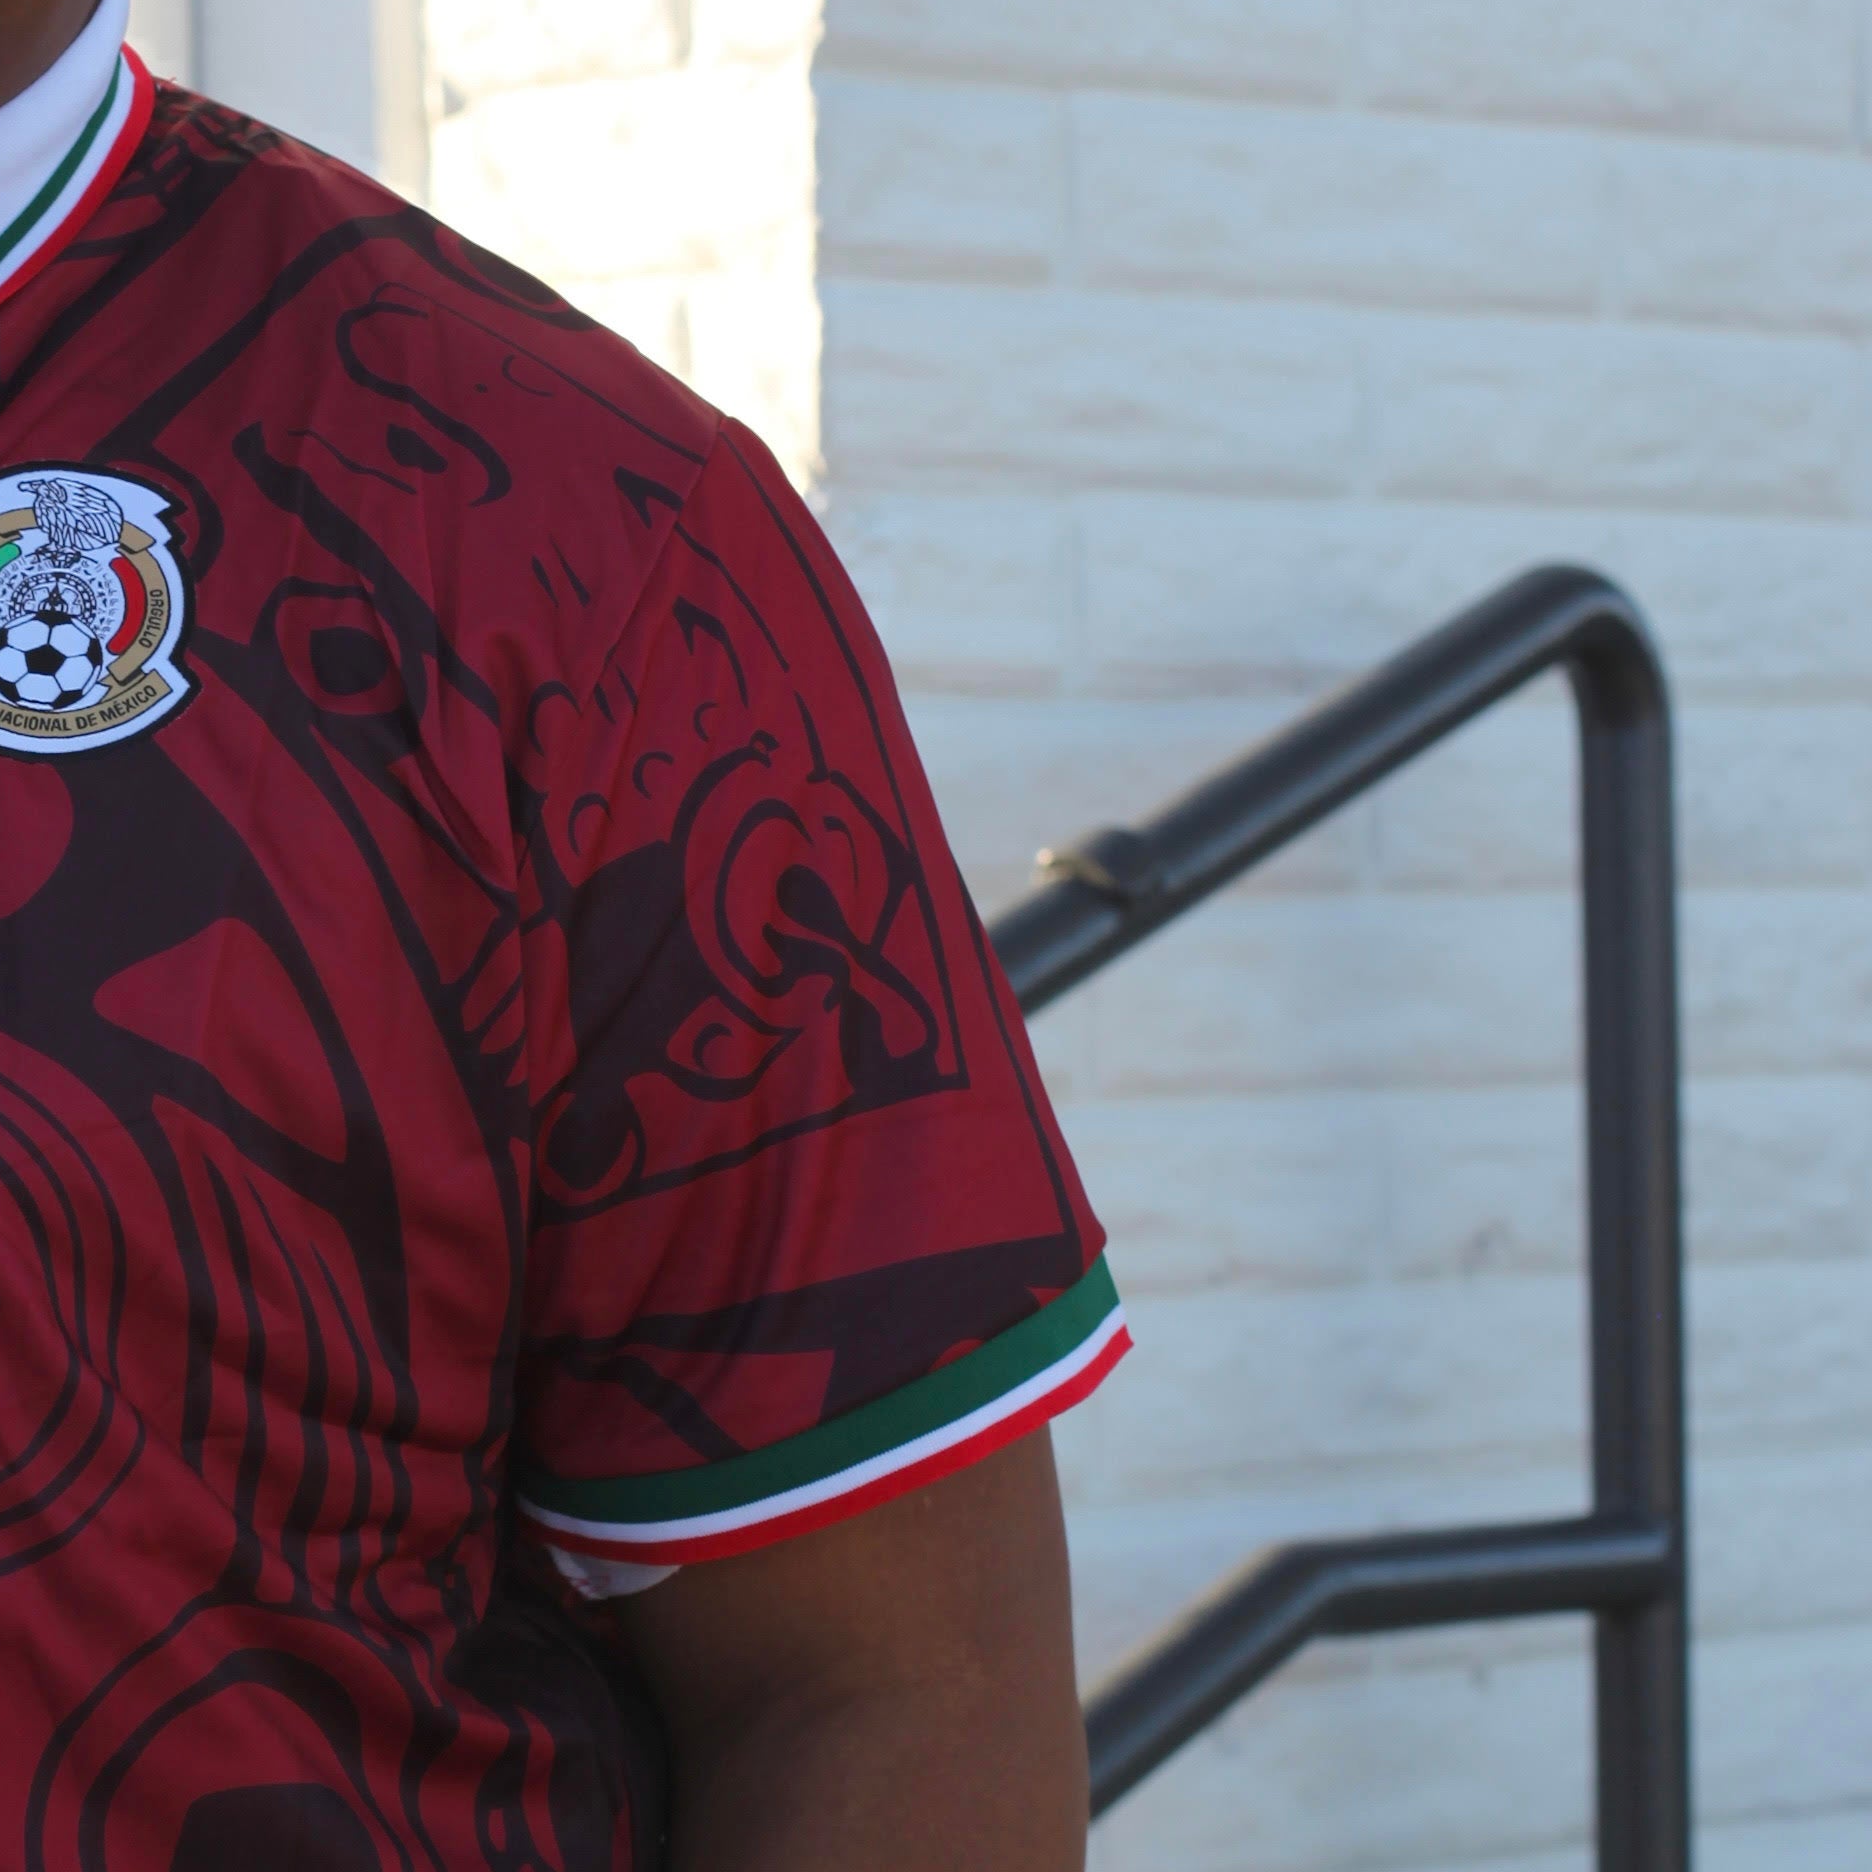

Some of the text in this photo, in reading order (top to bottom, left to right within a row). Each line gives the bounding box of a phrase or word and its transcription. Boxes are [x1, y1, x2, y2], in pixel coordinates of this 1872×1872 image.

[138, 588, 163, 649] ORGULLO
[75, 714, 98, 731] DE
[101, 684, 158, 723] MÉXICO
